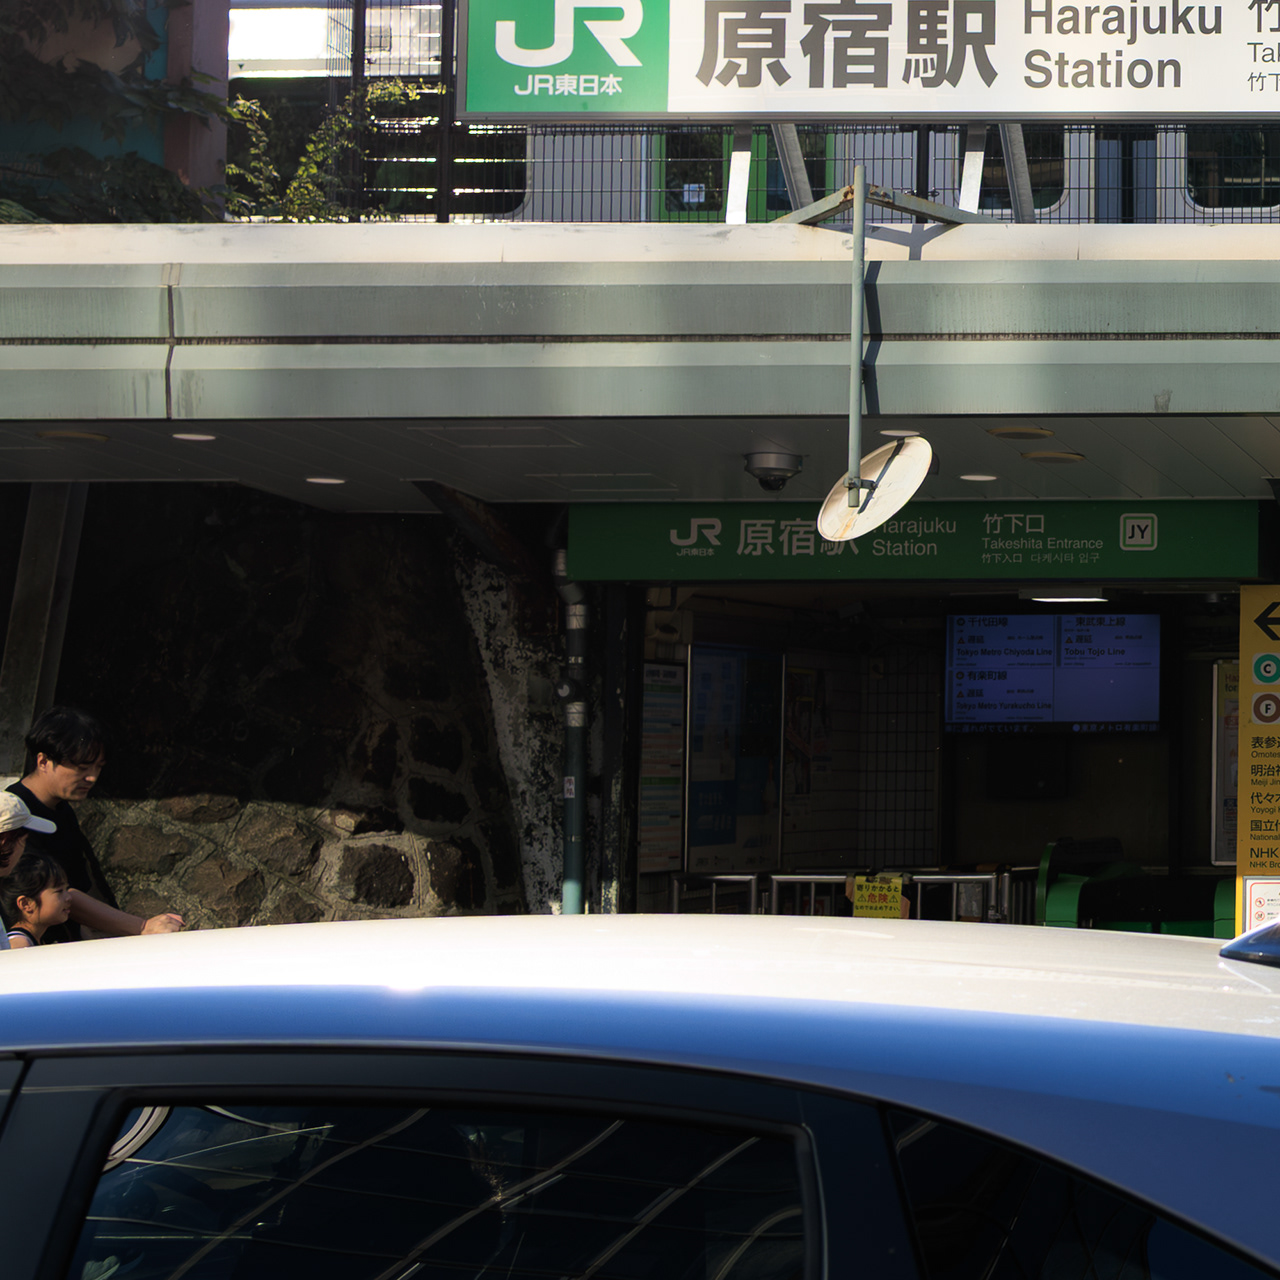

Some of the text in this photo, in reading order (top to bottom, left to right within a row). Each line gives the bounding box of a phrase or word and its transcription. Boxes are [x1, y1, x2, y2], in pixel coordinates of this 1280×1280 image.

[1023, 49, 1182, 89] Station
[514, 74, 623, 96] JR東日本
[982, 513, 1045, 534] 竹下口
[670, 518, 722, 546] JR
[1128, 524, 1149, 539] JY
[872, 539, 938, 556] Station
[982, 537, 1103, 549] Takeshita Entrance
[677, 548, 715, 556] JR東日本
[981, 553, 1023, 564] 竹下入口
[1030, 553, 1101, 564] 다케시타 입구
[968, 617, 1008, 628] 千代田線
[1036, 648, 1052, 656] Line
[1064, 648, 1125, 657] Tobu Tojo Line
[1263, 664, 1271, 674] C
[1264, 704, 1271, 714] F
[1251, 778, 1268, 786] Meiji
[1250, 806, 1276, 814] Yoyogi
[1250, 848, 1278, 858] NHK
[867, 893, 889, 904] 危険
